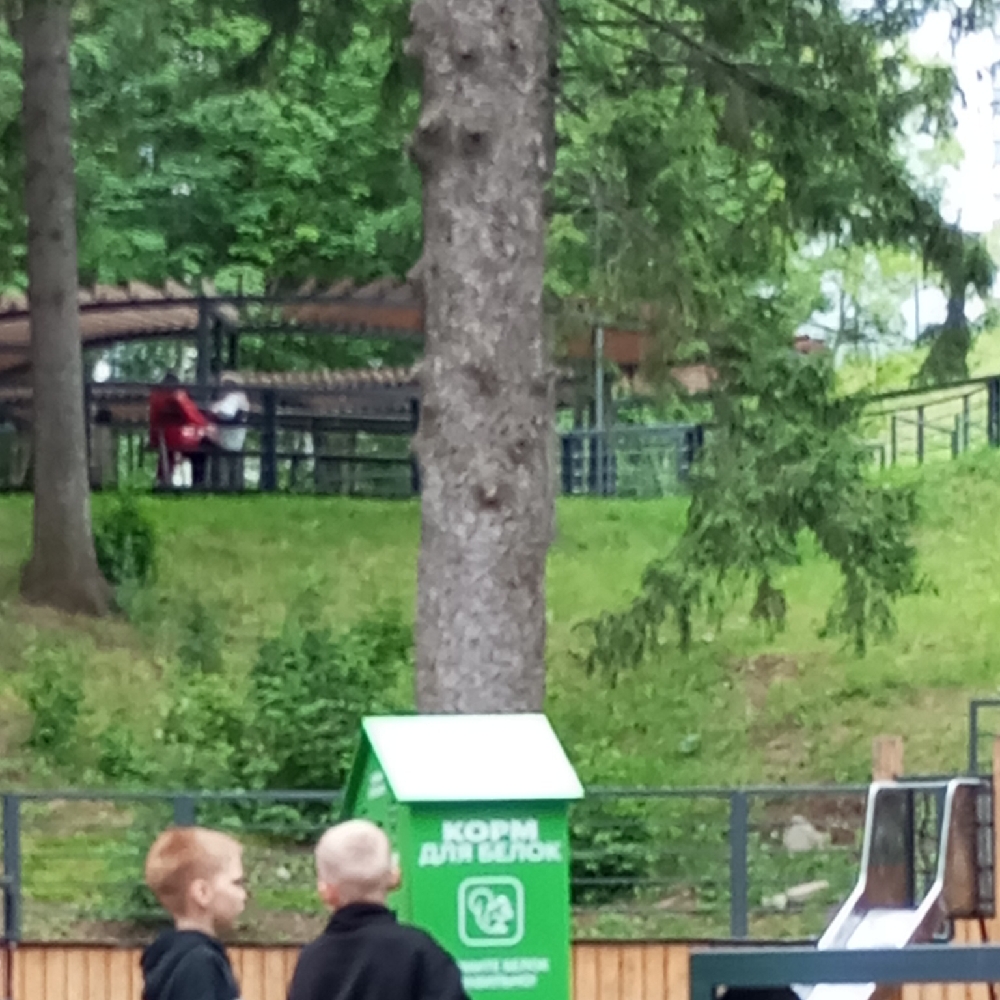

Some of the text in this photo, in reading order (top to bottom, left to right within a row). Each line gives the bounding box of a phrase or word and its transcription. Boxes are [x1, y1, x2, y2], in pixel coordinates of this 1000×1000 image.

[442, 818, 539, 843] КОРМ
[418, 841, 562, 867] ДЛЯ БЕЛОК
